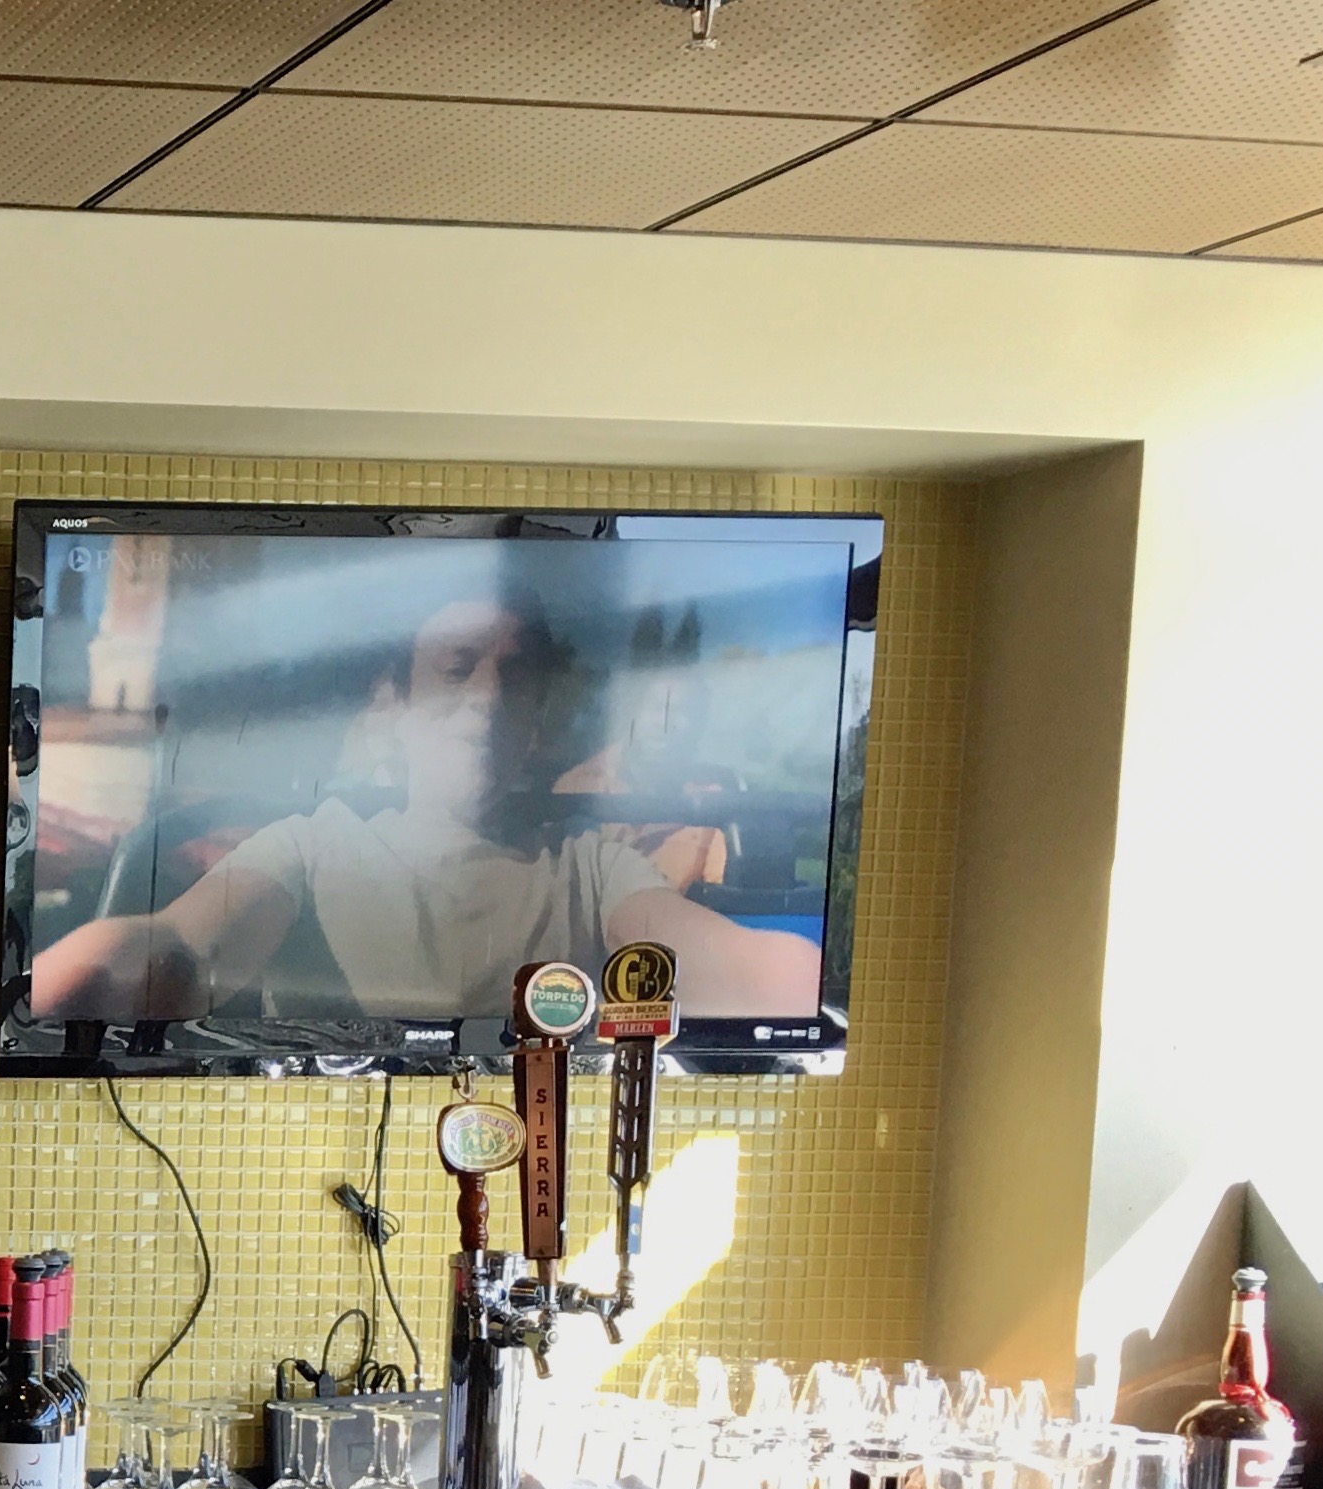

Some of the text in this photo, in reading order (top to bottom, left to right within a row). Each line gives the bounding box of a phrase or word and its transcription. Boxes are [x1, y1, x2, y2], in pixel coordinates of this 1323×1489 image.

[52, 518, 88, 529] AQUOS
[531, 989, 587, 1004] TORPEDO
[405, 1029, 455, 1041] SHARP
[535, 1088, 550, 1218] SIERRA
